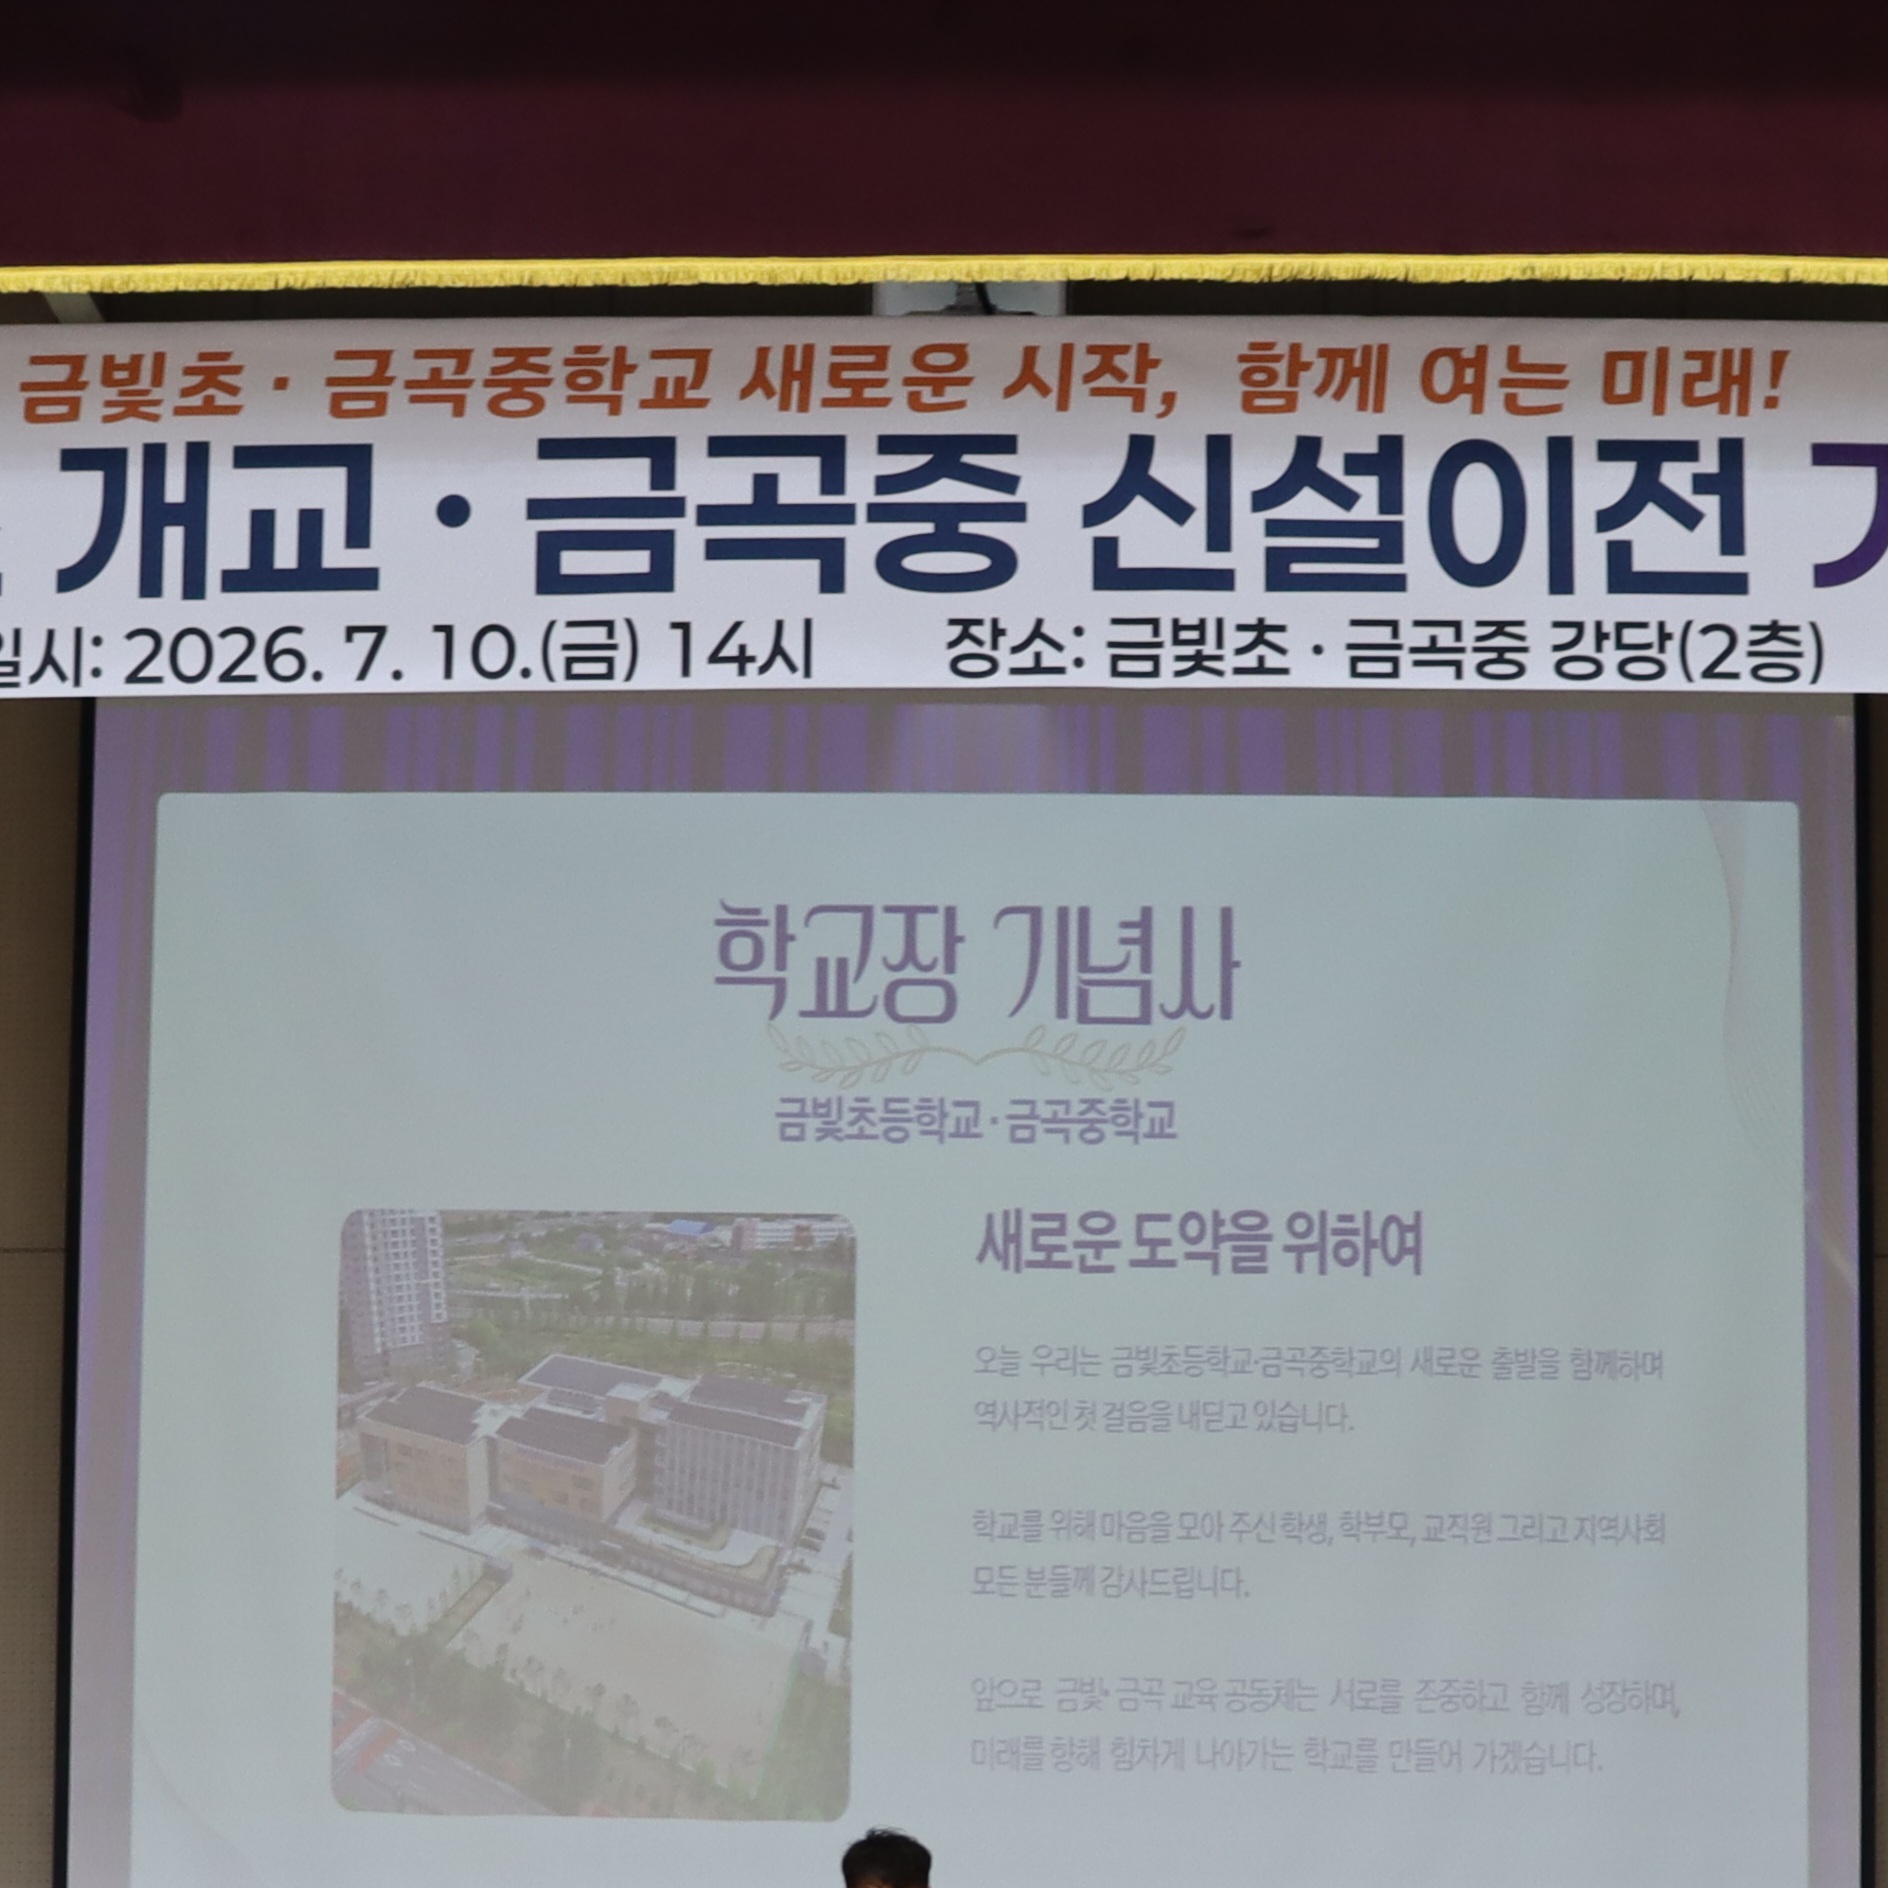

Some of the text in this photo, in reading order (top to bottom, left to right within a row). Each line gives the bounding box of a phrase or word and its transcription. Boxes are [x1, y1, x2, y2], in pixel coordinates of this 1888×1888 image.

[19, 351, 244, 424] 금빛초
[326, 344, 713, 419] 금곡중학교
[740, 342, 975, 414] 새로운
[1004, 342, 1177, 418] 시작,
[1238, 341, 1390, 414] 함께
[1420, 344, 1570, 416] 여는
[1603, 346, 1791, 416] 미래!
[55, 437, 380, 601] 개교
[526, 433, 1022, 597] 금곡중
[1081, 432, 1752, 597] 신설이전
[669, 619, 816, 680] 14시
[945, 616, 1085, 681] 장소:
[1106, 616, 1291, 679] 금빛초
[1345, 618, 1530, 681] 금곡중
[1551, 616, 1825, 686] 강당(2층)
[713, 899, 1242, 1026] 학교장 기념사
[975, 1208, 1424, 1278] 새로운 도약을 위하여
[973, 1344, 1023, 1378] 오늘
[1030, 1344, 1104, 1378] 우리는
[1409, 1345, 1482, 1379] 새로운
[1490, 1345, 1561, 1381] 출발을
[1568, 1346, 1665, 1382] 함께하며
[973, 1399, 1069, 1433] 역사적인
[1074, 1399, 1097, 1433] 첫
[1102, 1399, 1172, 1433] 걸음을
[1253, 1399, 1355, 1434] 있습니다.
[971, 1508, 1044, 1543] 학교를
[1050, 1508, 1096, 1542] 위해
[1100, 1509, 1172, 1543] 마음을
[1176, 1510, 1225, 1543] 모아
[1228, 1510, 1276, 1544] 주신
[1421, 1511, 1493, 1545] 교직원
[1496, 1512, 1570, 1545] 그리고
[1573, 1512, 1666, 1547] 지역사회
[971, 1564, 1251, 1599] 모든 분들께 감사드립니다.
[970, 1676, 1045, 1714] 앞으로
[1170, 1677, 1219, 1713] 교육
[1224, 1676, 1319, 1713] 공동체는
[1328, 1677, 1405, 1715] 서로를
[1414, 1677, 1511, 1715] 존중하고
[1520, 1679, 1570, 1717] 함께
[970, 1735, 1047, 1772] 미래를
[1050, 1735, 1101, 1773] 향해
[1109, 1735, 1186, 1773] 힘차게
[1195, 1736, 1296, 1773] 나아가는
[1303, 1736, 1380, 1774] 학교를
[1388, 1738, 1463, 1774] 만들어
